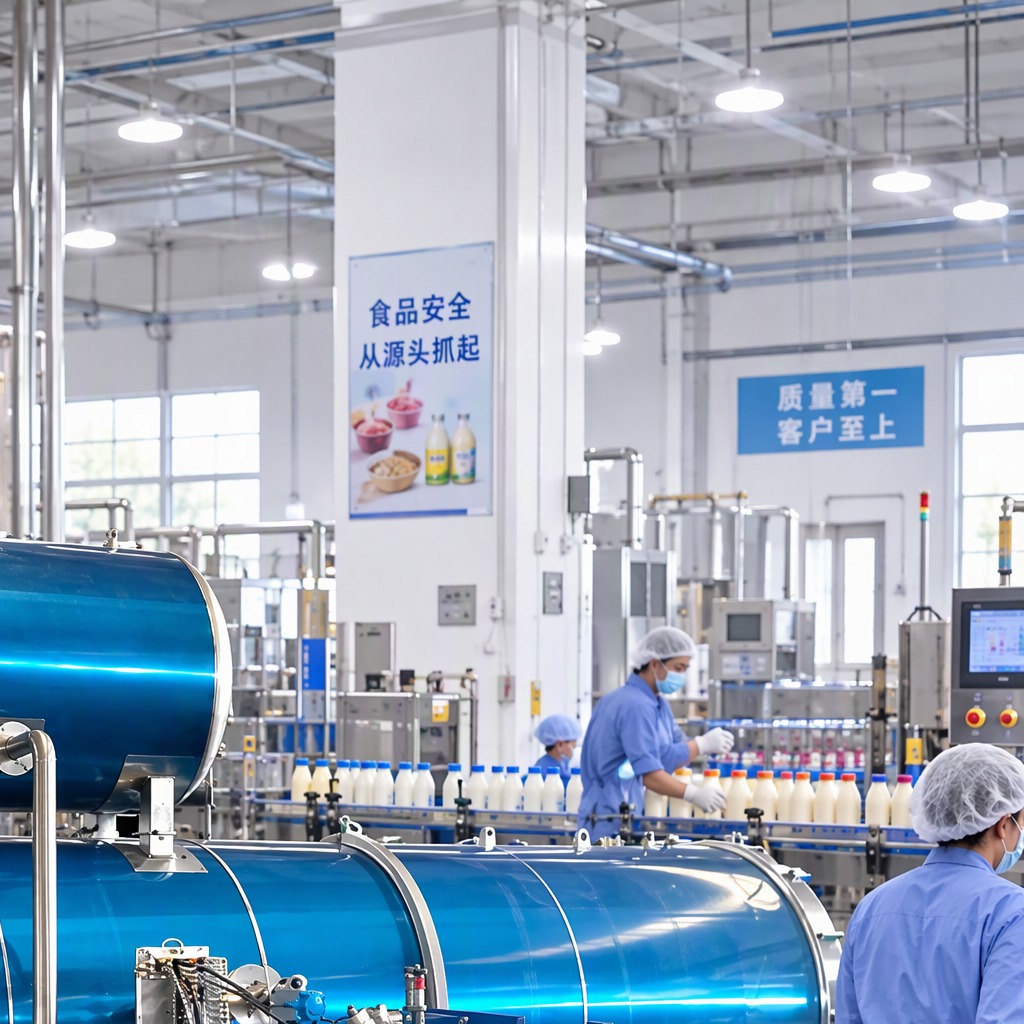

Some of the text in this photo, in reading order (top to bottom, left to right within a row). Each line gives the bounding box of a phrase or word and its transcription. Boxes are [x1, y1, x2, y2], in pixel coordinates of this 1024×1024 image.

[369, 292, 471, 328] 食品安全
[359, 334, 480, 369] 从源头抓起
[778, 379, 897, 412] 质量第一
[778, 412, 896, 446] 客户至上
